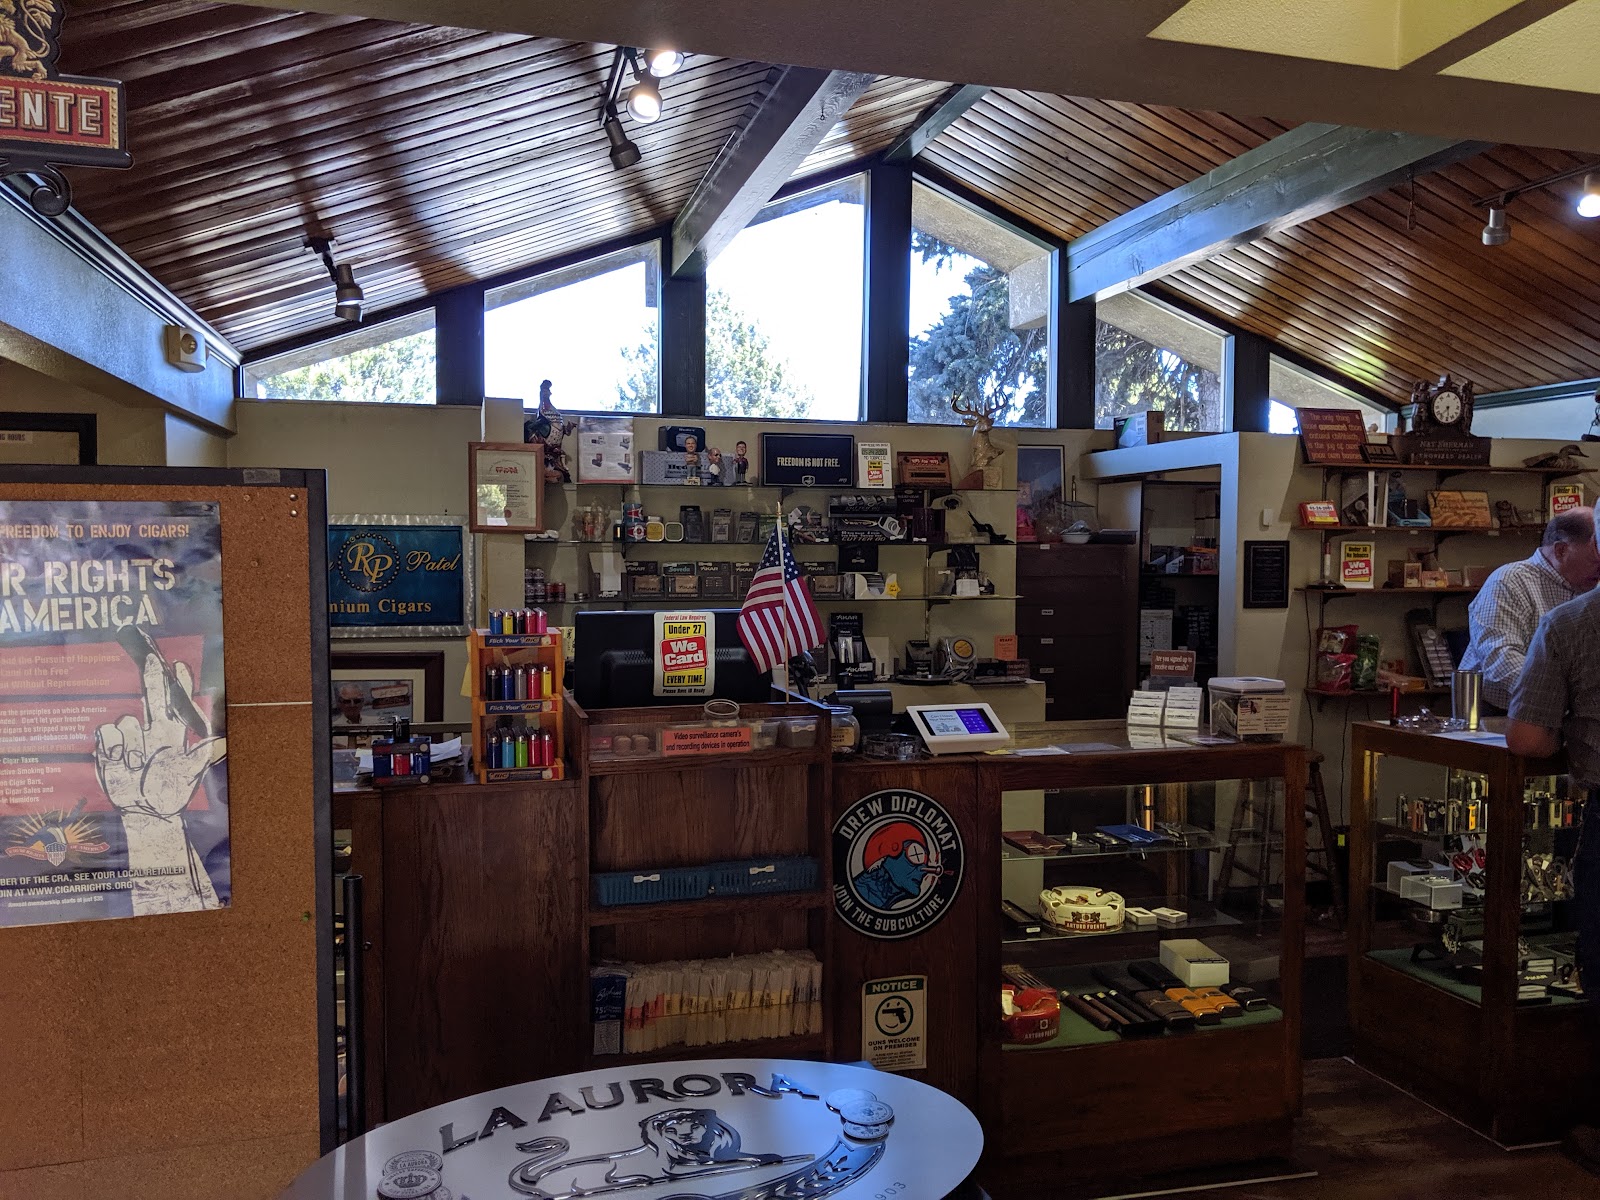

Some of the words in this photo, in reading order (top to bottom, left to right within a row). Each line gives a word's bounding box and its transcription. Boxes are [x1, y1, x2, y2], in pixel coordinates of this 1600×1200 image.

[777, 457, 804, 467] FREEDOM
[805, 458, 811, 467] IS
[812, 458, 823, 468] NOT
[1557, 496, 1575, 504] We
[66, 525, 84, 538] TO
[91, 525, 131, 538] ENJOY
[139, 524, 189, 538] CIGARS!
[406, 550, 462, 571] Patel
[1348, 561, 1365, 569] We
[44, 558, 176, 595] RIGHTS
[1344, 567, 1369, 576] Card
[378, 599, 432, 615] Cigars
[0, 594, 158, 633] AMERICA
[668, 624, 690, 635] Under
[693, 624, 702, 634] 27
[670, 640, 698, 653] We
[35, 656, 64, 664] Pursuit
[67, 655, 75, 663] of
[664, 650, 705, 666] Card
[34, 667, 48, 675] the
[50, 667, 69, 675] Free
[47, 679, 110, 689] Representation
[667, 675, 686, 684] EVERY
[687, 674, 703, 683] TIME
[81, 706, 107, 714] America
[32, 725, 59, 734] stripped
[674, 732, 688, 740] Video
[720, 730, 742, 738] camera's
[676, 742, 700, 752] recording
[727, 740, 750, 750] operation
[3, 757, 19, 765] Cigar
[18, 767, 44, 775] Smoking
[9, 779, 26, 788] Cigar
[5, 788, 22, 796] Cigar
[9, 795, 40, 803] Humidors
[839, 798, 883, 841] DREW
[891, 796, 957, 852] DIPLOMAT
[20, 877, 31, 885] OF
[33, 876, 49, 884] THE
[74, 872, 90, 881] SEE
[91, 871, 115, 880] YOUR
[118, 869, 145, 878] LOCAL
[146, 866, 186, 877] RETAILER
[27, 881, 133, 896] WWW.CIGARRIGHTS.ORG
[28, 899, 60, 907] membership
[834, 884, 854, 911] JOIN
[852, 906, 875, 928] THE
[875, 894, 945, 932] SUBCULTURE
[872, 980, 918, 993] NOTICE
[868, 1039, 887, 1047] GUNS
[888, 1036, 921, 1044] WELCOME
[884, 1042, 917, 1050] PREMISES
[439, 1106, 528, 1156] LA
[537, 1073, 819, 1125] AURORA
